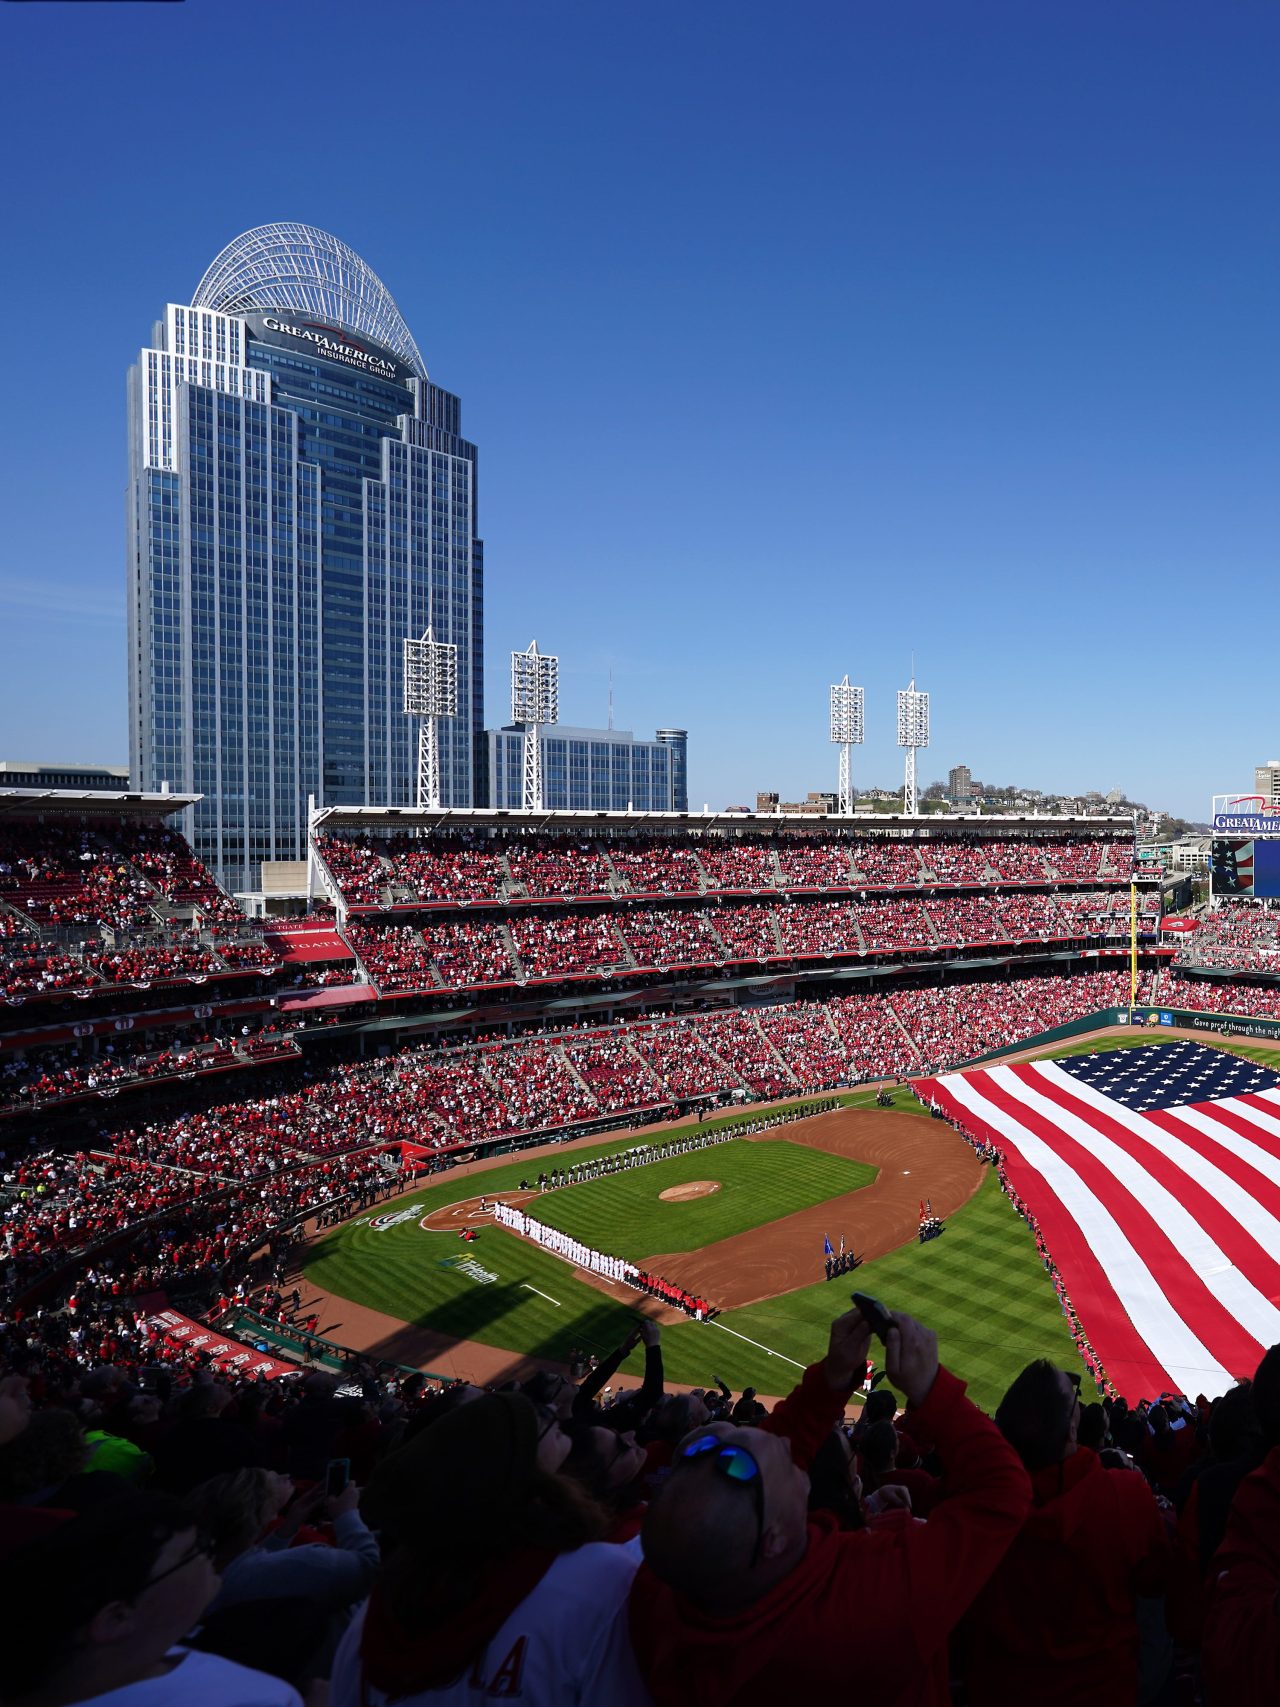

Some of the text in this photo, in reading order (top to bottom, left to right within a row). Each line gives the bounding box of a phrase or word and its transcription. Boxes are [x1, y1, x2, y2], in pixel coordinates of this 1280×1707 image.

[317, 347, 396, 379] INSURANCE GROUP
[1194, 1017, 1209, 1027] Gave
[1210, 1021, 1228, 1030] proof
[1228, 1022, 1254, 1035] through
[1255, 1026, 1266, 1035] the
